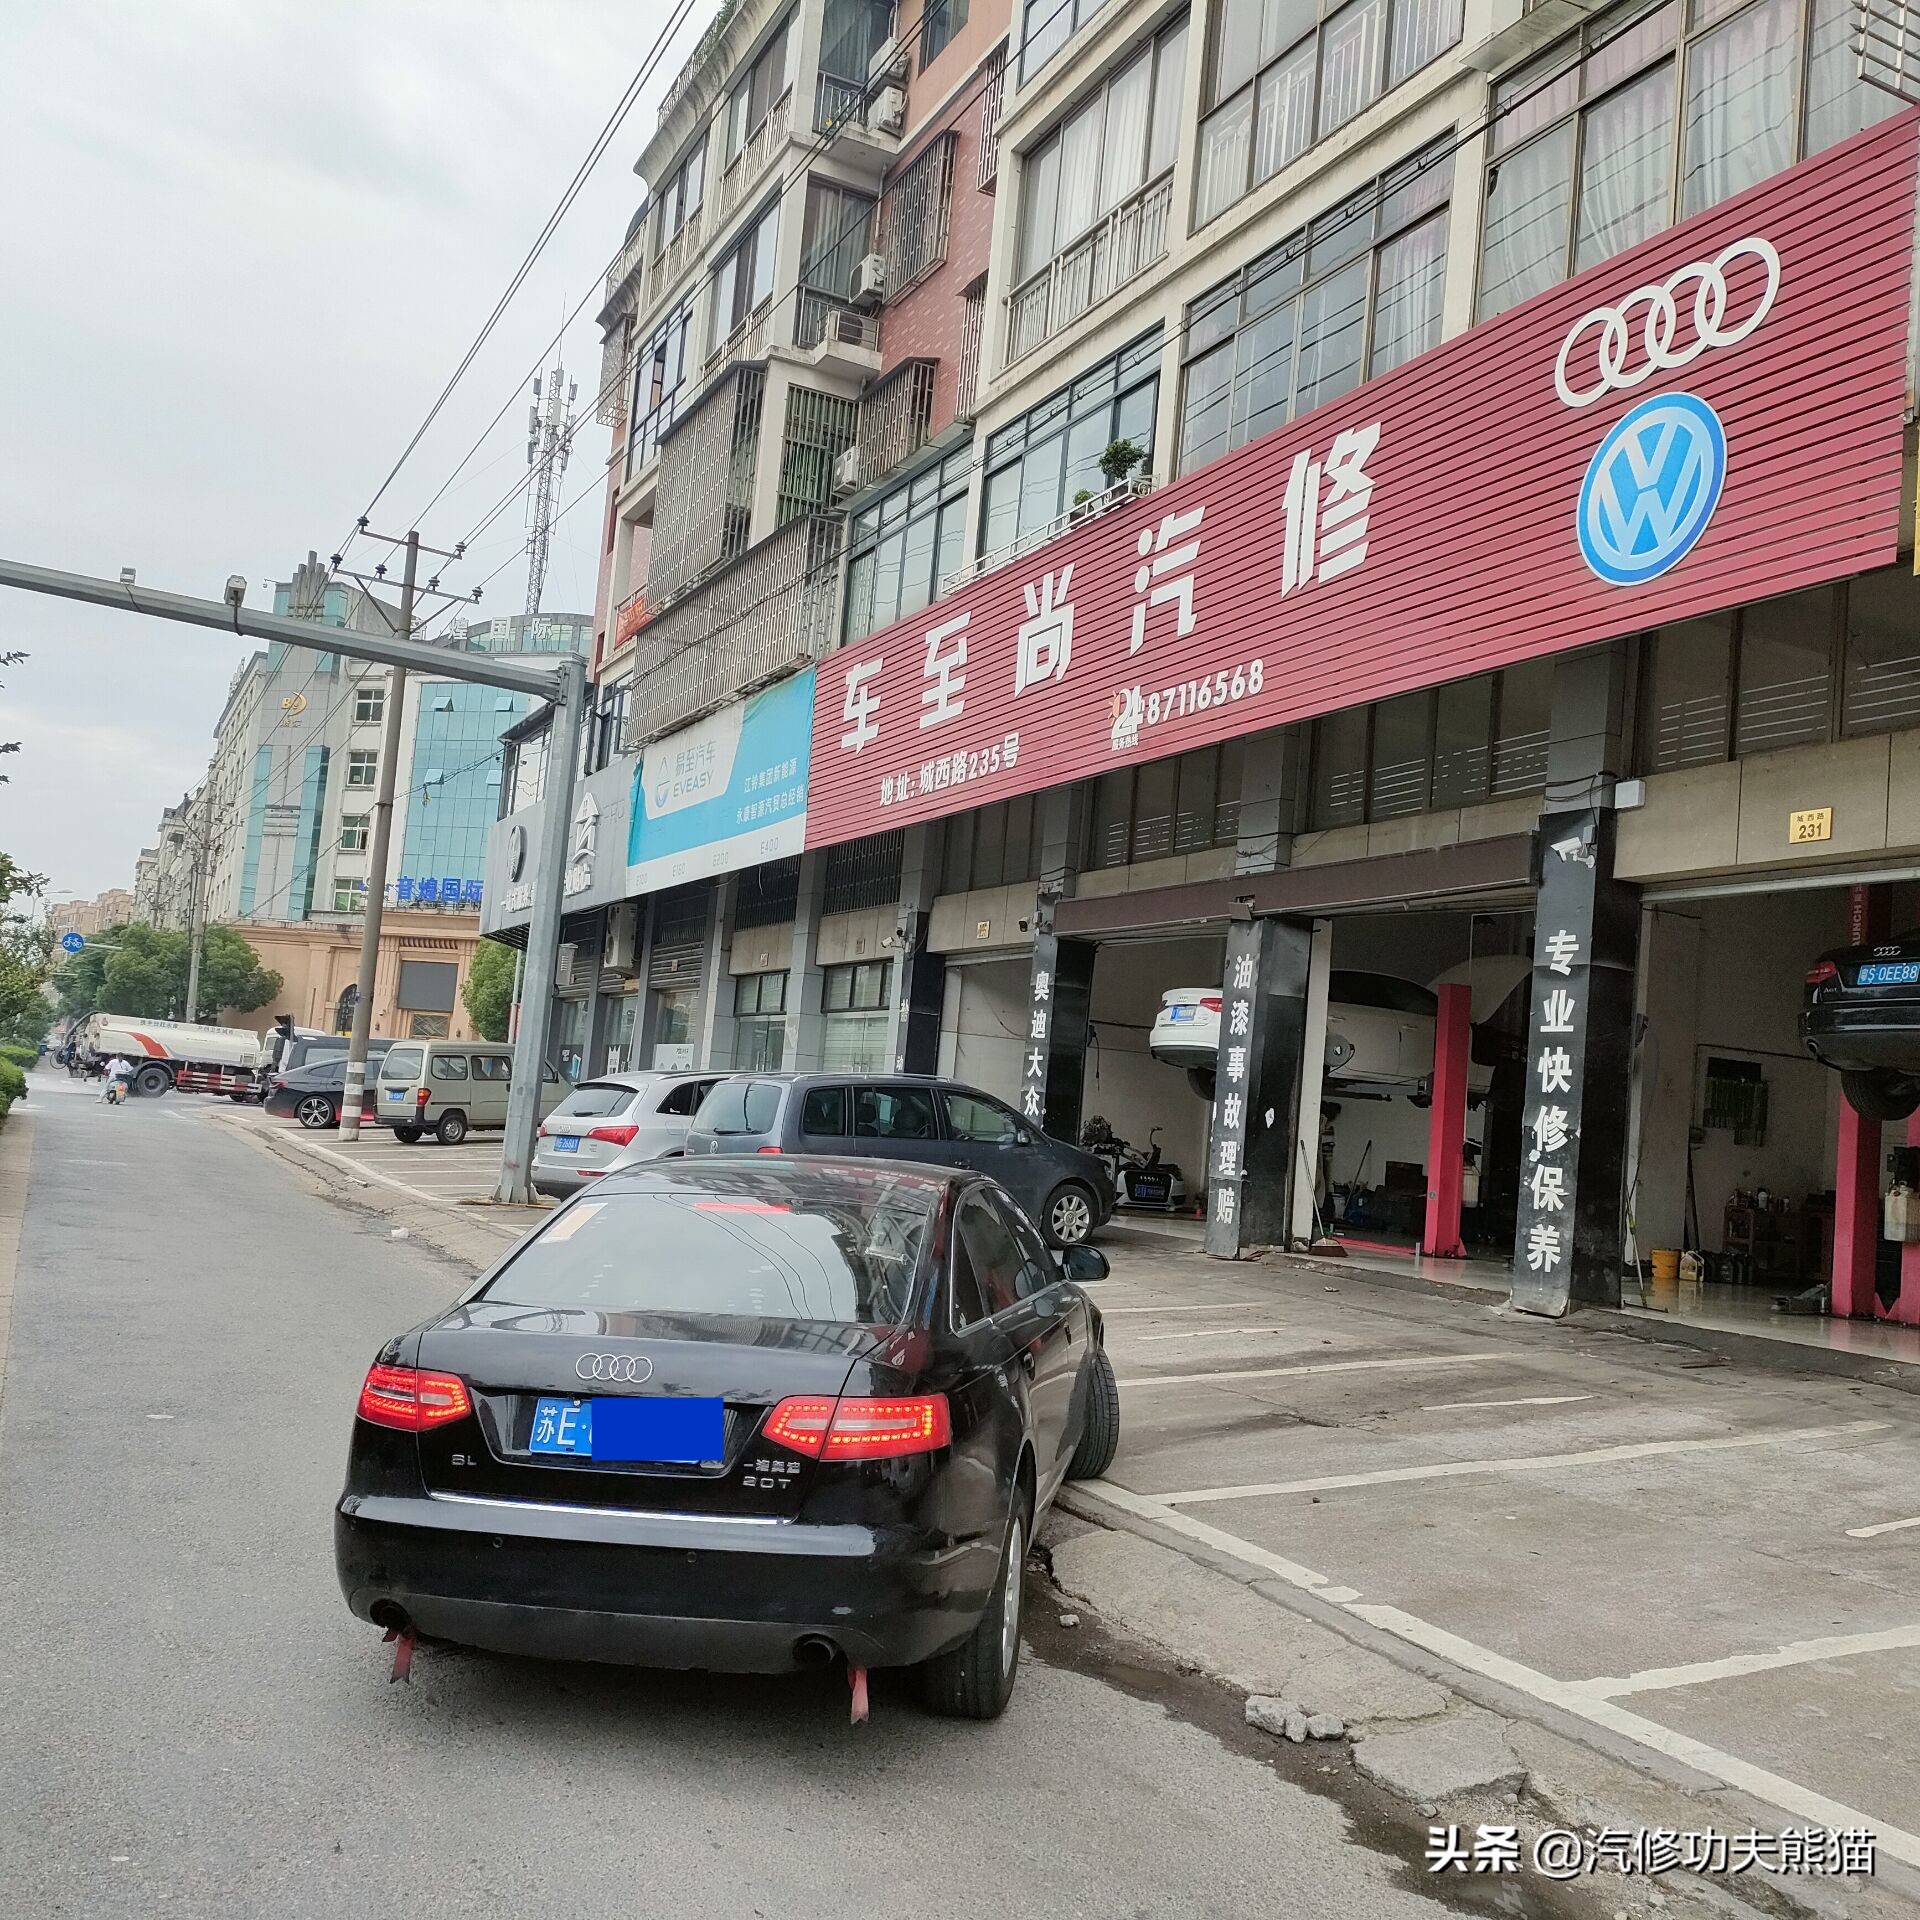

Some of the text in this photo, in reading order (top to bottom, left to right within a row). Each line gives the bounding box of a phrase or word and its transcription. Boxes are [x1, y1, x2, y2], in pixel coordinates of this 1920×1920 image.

[841, 421, 1382, 757] 车至尚汽修
[1147, 658, 1264, 725] 87116568
[673, 770, 715, 798] EVEASY
[675, 740, 717, 777] 易至汽车
[760, 837, 779, 855] E400
[1798, 822, 1822, 840] 231
[1851, 903, 1862, 947] AUNCH
[1022, 970, 1050, 1117] 奥迪大众
[1214, 954, 1254, 1226] 油漆事故理赔
[1526, 928, 1580, 1274] 专业快修保养
